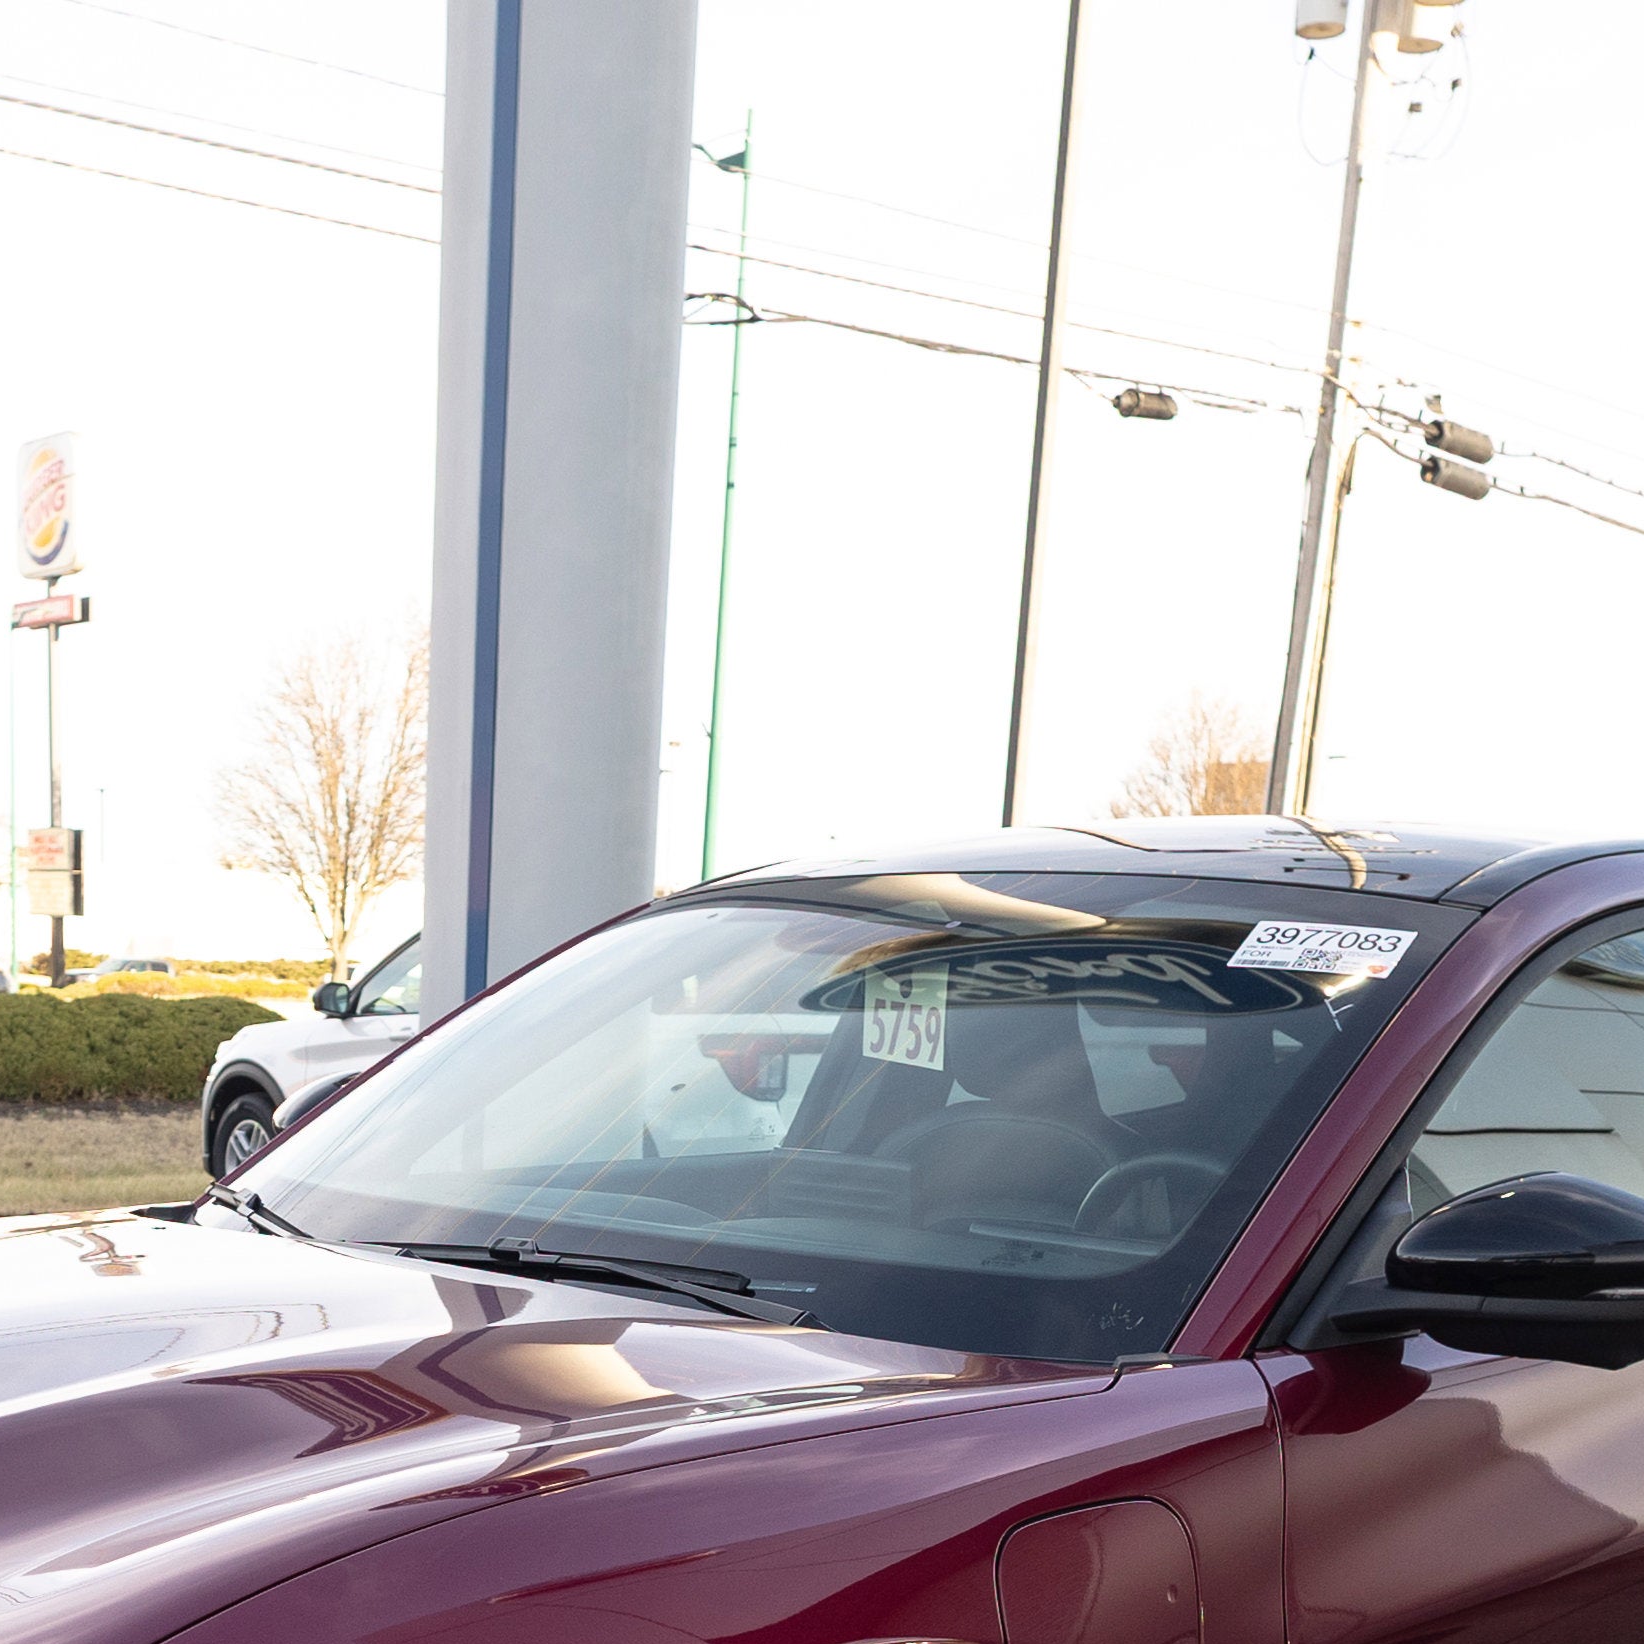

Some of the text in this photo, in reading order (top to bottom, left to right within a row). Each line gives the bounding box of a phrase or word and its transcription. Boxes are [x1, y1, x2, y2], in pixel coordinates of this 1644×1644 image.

[1256, 926, 1402, 953] 3977083
[1240, 950, 1272, 958] FOR
[869, 998, 942, 1063] 5759
